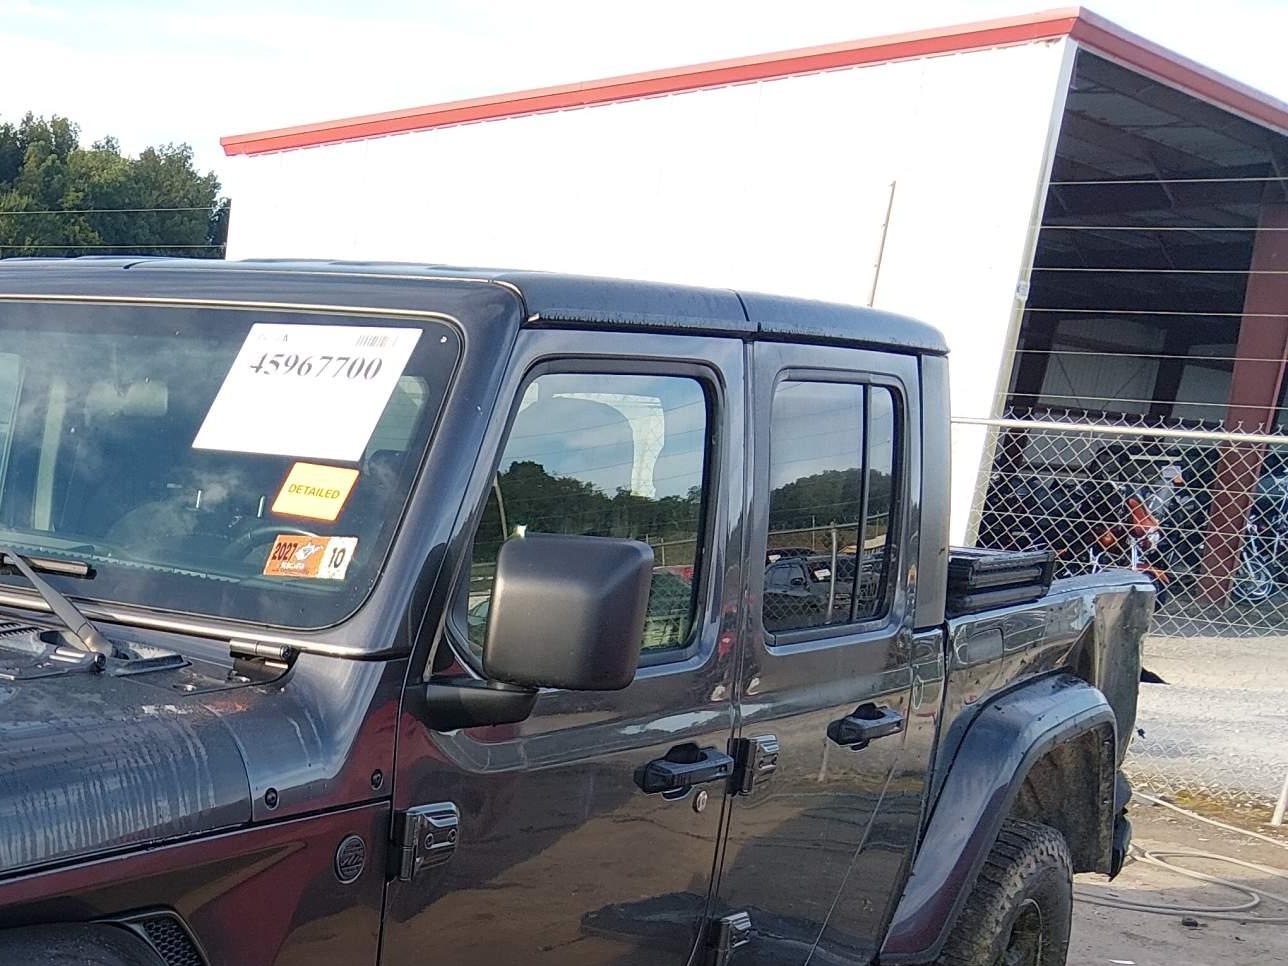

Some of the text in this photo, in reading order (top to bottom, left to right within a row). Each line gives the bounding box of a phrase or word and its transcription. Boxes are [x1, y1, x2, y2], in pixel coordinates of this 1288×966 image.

[249, 352, 383, 381] 45967700
[287, 483, 341, 500] DETAILED
[272, 542, 298, 561] 2027
[328, 547, 346, 569] 10
